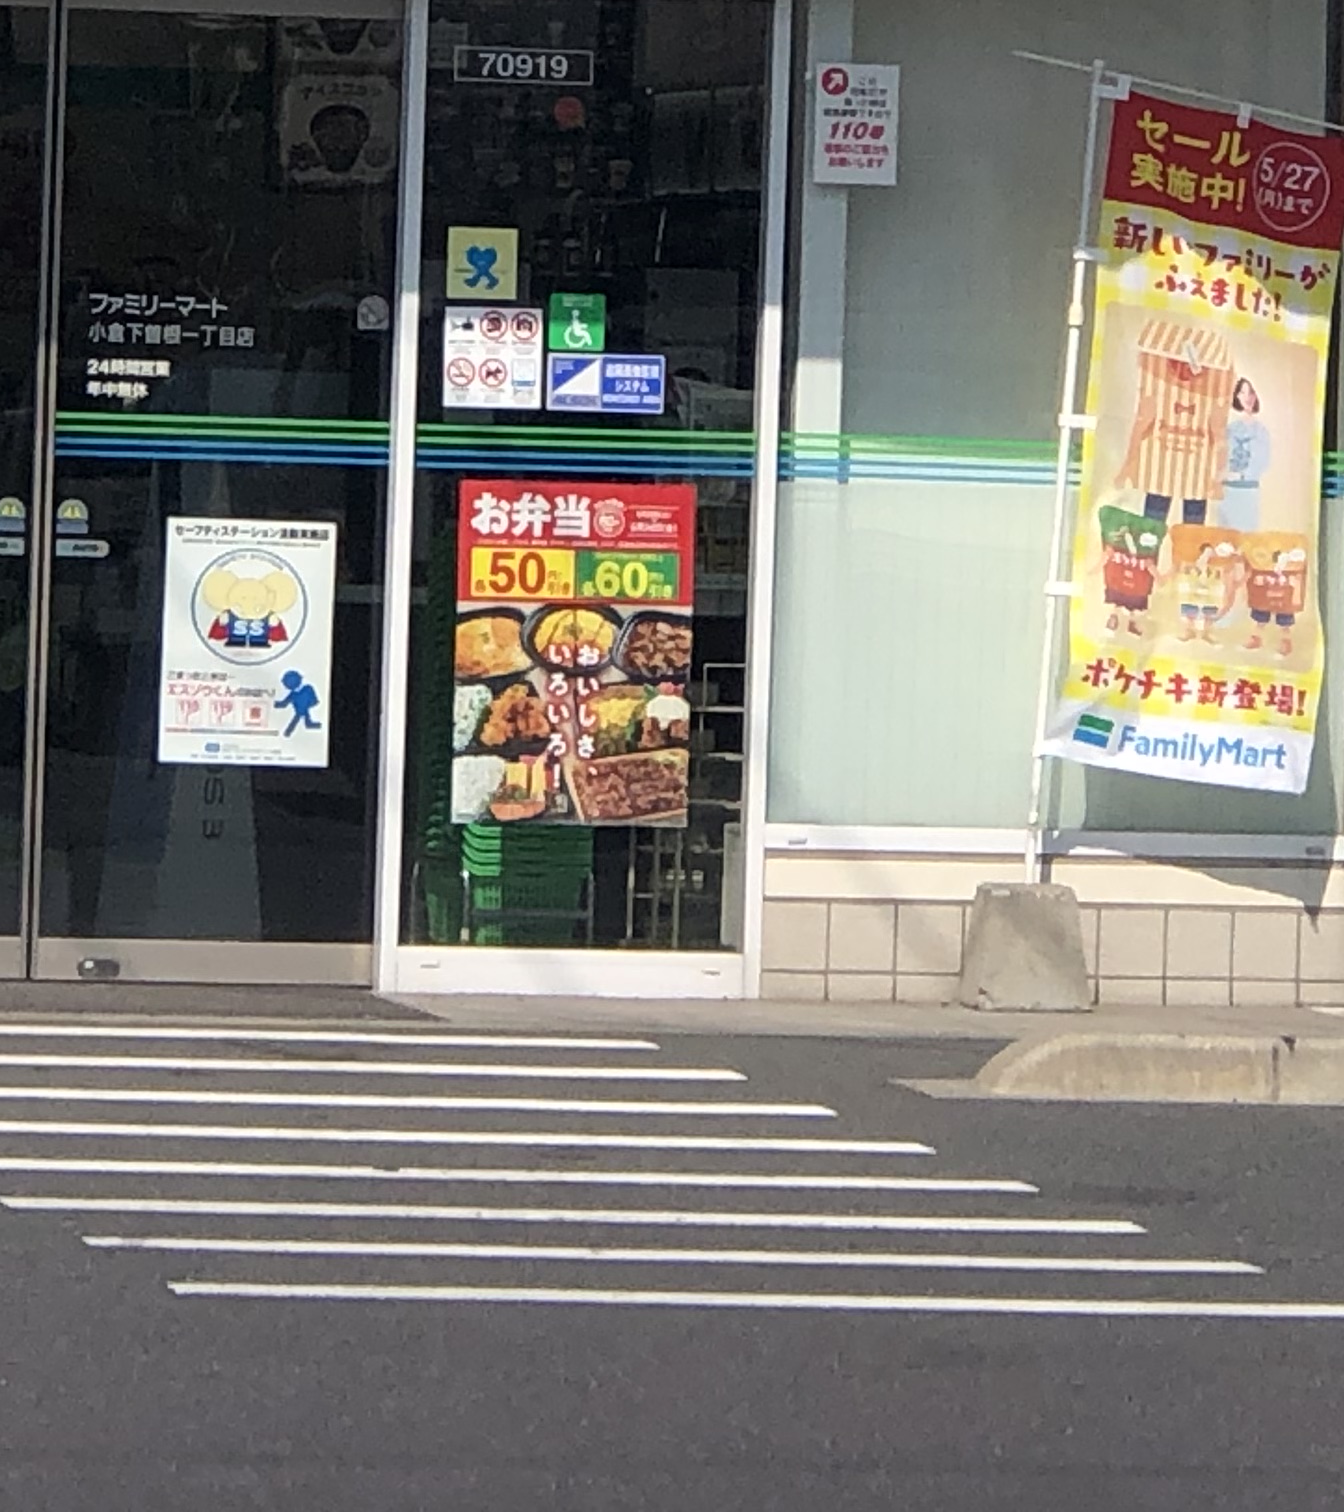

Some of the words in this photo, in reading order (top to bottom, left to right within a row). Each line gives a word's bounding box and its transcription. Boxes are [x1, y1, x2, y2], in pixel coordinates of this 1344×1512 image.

[478, 53, 569, 79] 70919
[1136, 109, 1251, 167] セール
[1130, 153, 1246, 212] 実施中!
[1259, 157, 1321, 193] 5/27
[1257, 187, 1314, 215] (月)まで
[1113, 216, 1331, 291] 新しいファミリーが
[89, 293, 229, 319] ファミリーマート
[1154, 264, 1282, 322] ふえました!
[470, 491, 591, 538] お弁当
[233, 620, 264, 635] SS
[1081, 657, 1307, 717] ポケチキ新登場!
[546, 644, 571, 789] いろいろ!
[1117, 724, 1287, 770] FamilyMart
